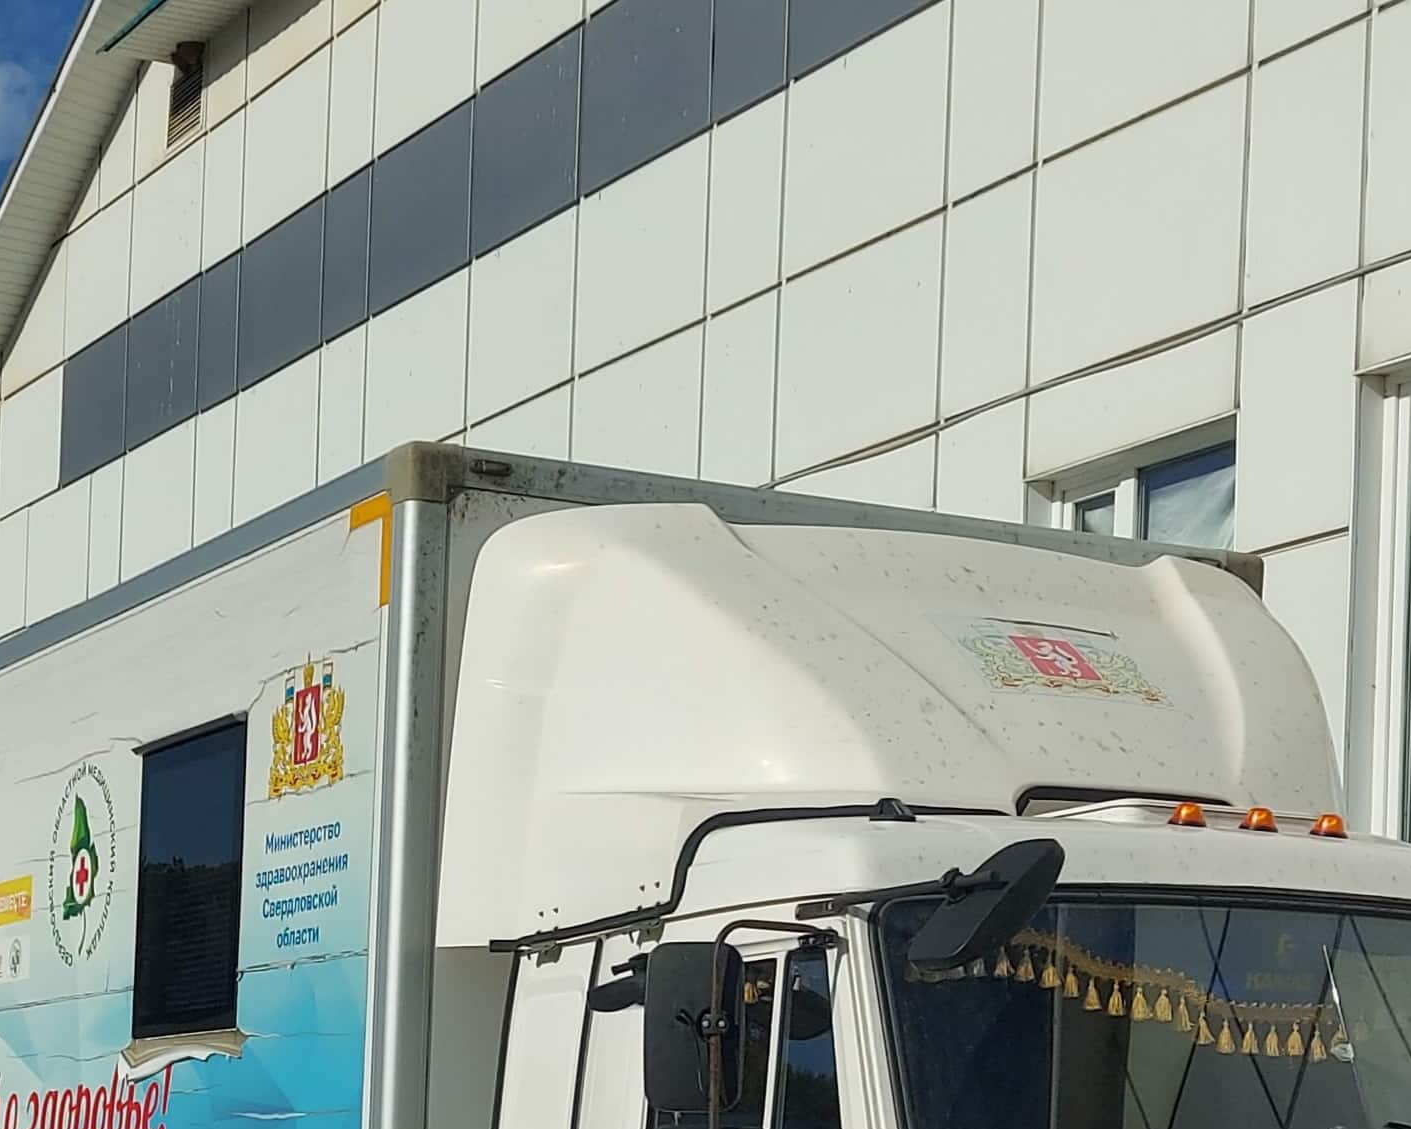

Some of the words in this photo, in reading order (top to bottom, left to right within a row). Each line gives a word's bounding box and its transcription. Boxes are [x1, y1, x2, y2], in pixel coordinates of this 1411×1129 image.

[52, 761, 87, 844] ОБЛАСТНОЙ
[265, 821, 341, 855] Министерство
[255, 853, 348, 891] здравоохранения
[262, 884, 338, 920] Свердловской
[276, 925, 319, 948] области
